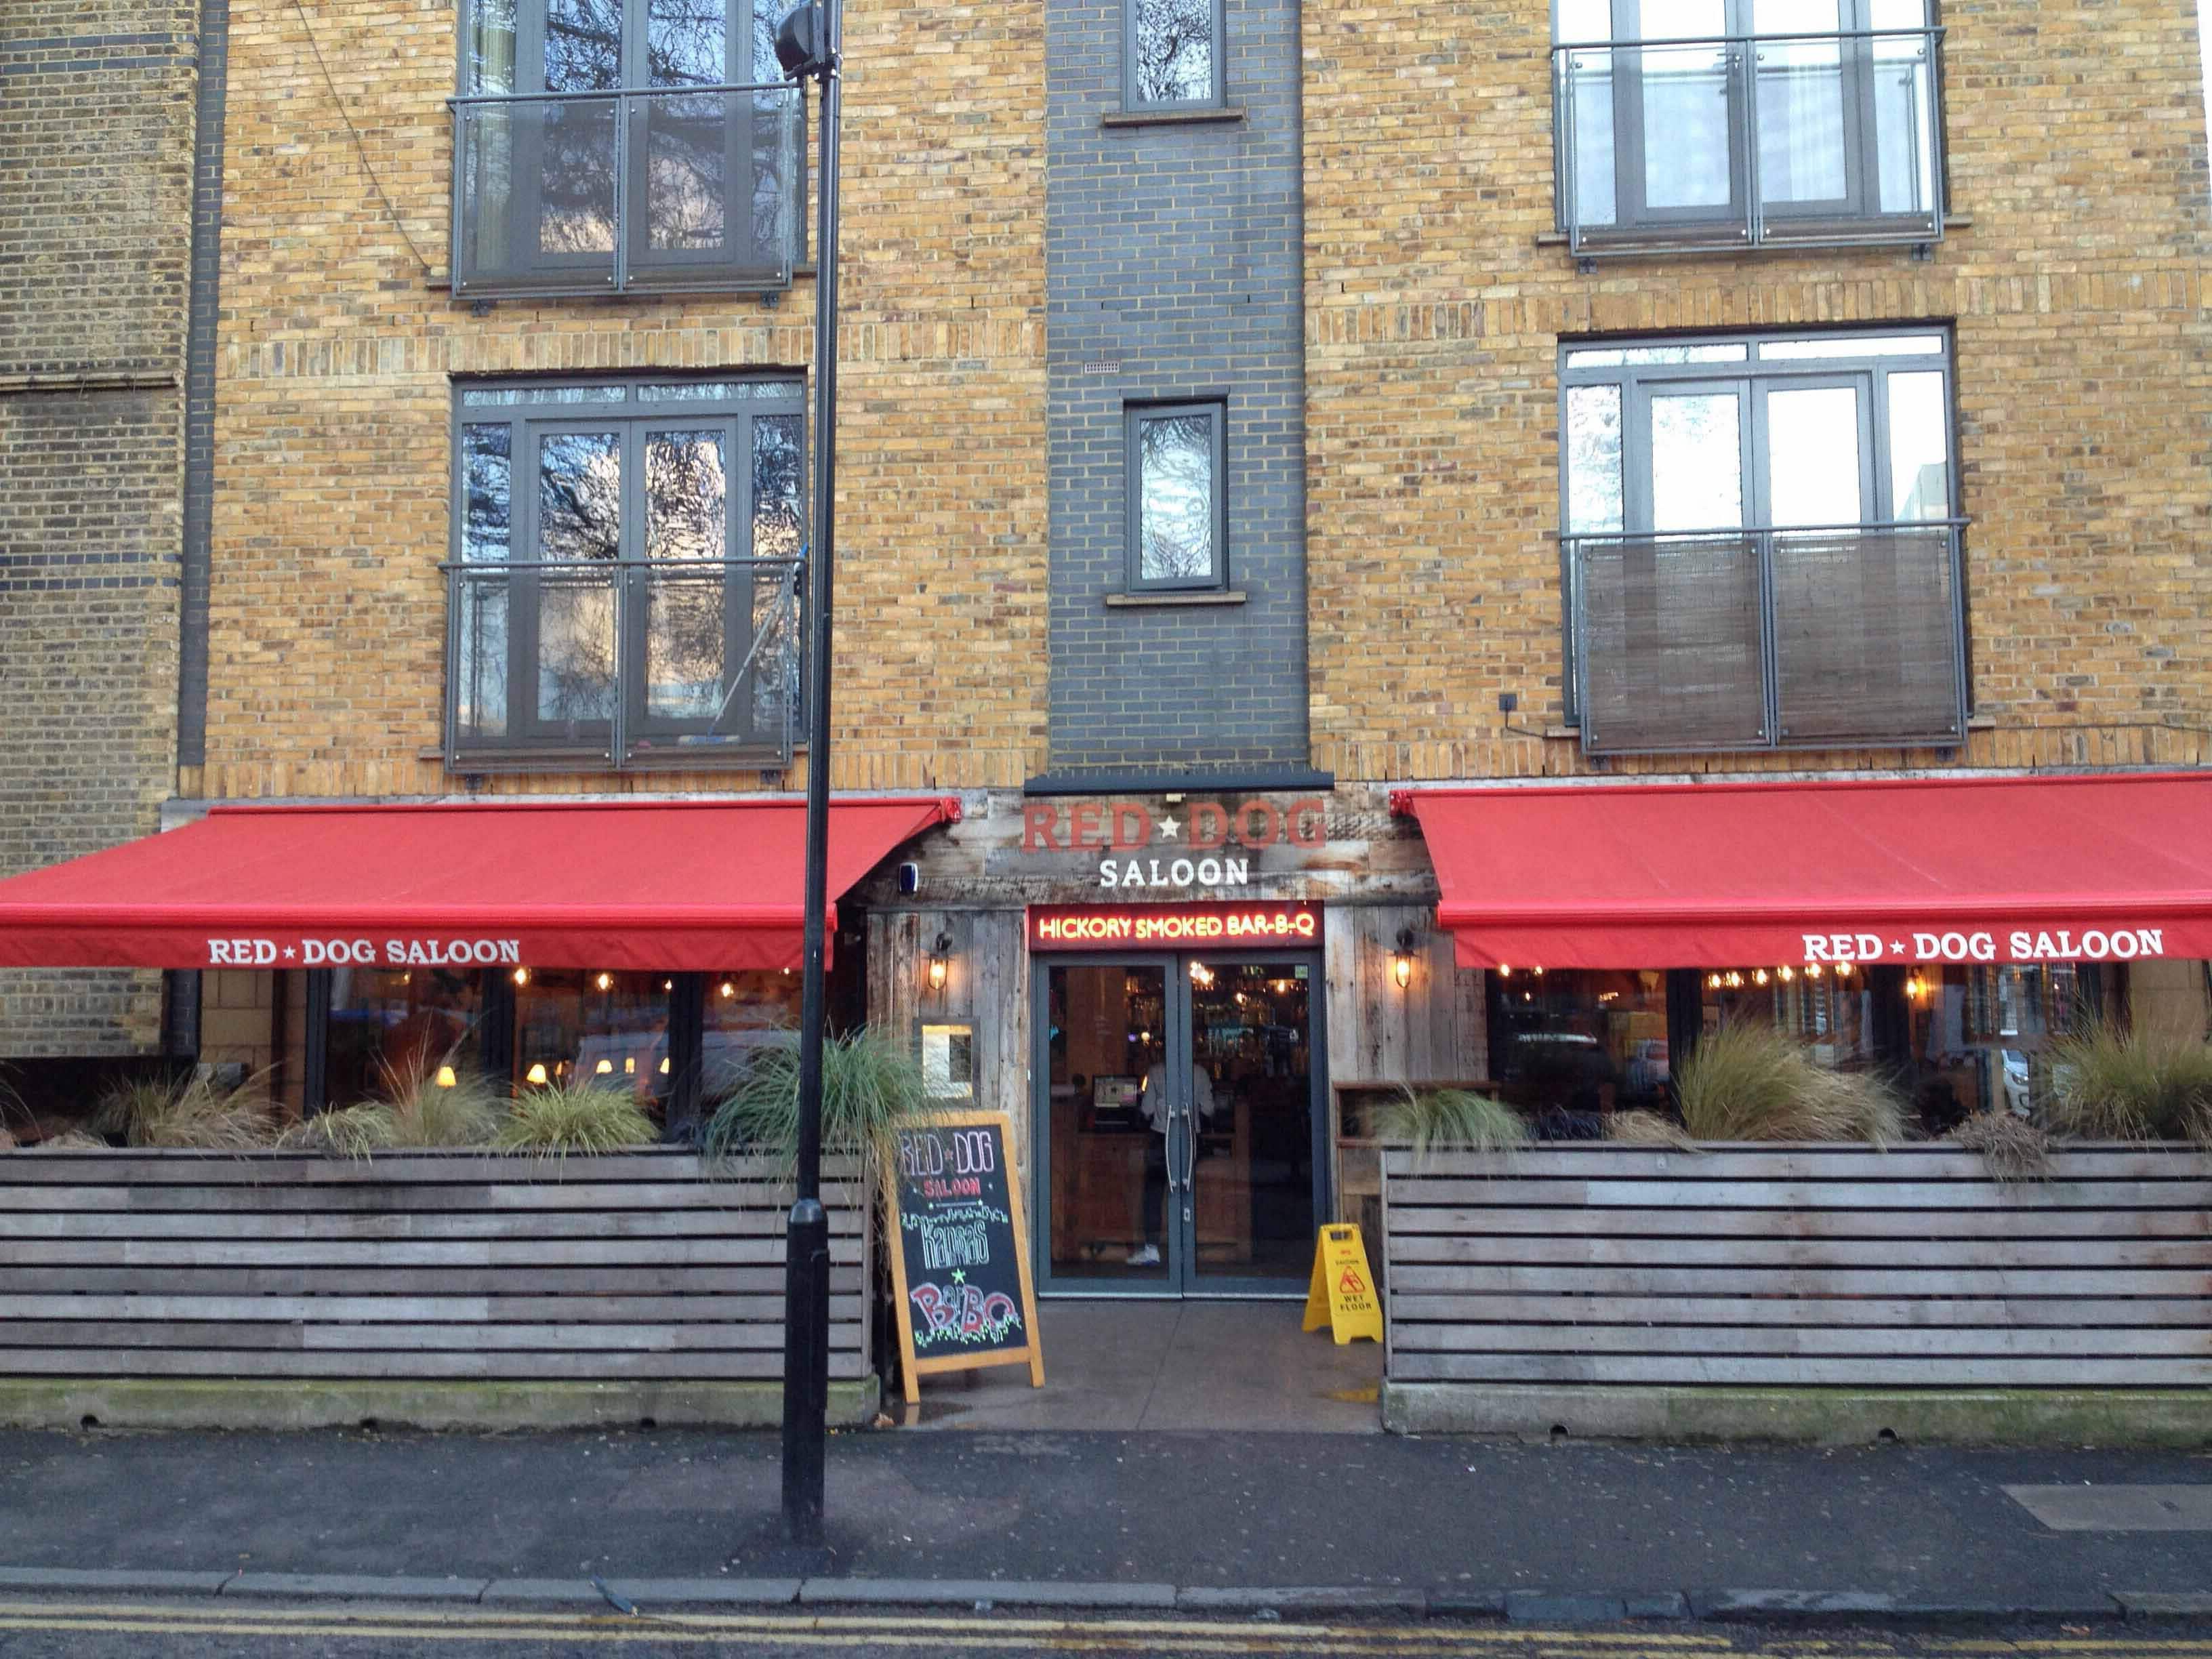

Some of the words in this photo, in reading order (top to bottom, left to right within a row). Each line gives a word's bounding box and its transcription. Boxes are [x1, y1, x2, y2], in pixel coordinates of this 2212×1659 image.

[1021, 802, 1151, 853] RED
[1185, 798, 1326, 851] DOG
[1099, 858, 1249, 887] SALOON
[1038, 917, 1132, 939] HICKORY
[1134, 916, 1223, 939] SMOKED
[1227, 913, 1315, 937] BAR-B-Q
[207, 939, 277, 964] RED
[302, 939, 376, 964] DOG
[386, 939, 520, 965] SALOON
[1802, 933, 1883, 961] RED
[1912, 932, 1996, 960] DOG
[2009, 929, 2164, 960] SALOON
[899, 1133, 943, 1176] RED
[953, 1131, 995, 1174] DOG
[923, 1176, 982, 1199] SALOON
[1340, 1302, 1372, 1312] FLOOR
[1343, 1294, 1364, 1303] WET
